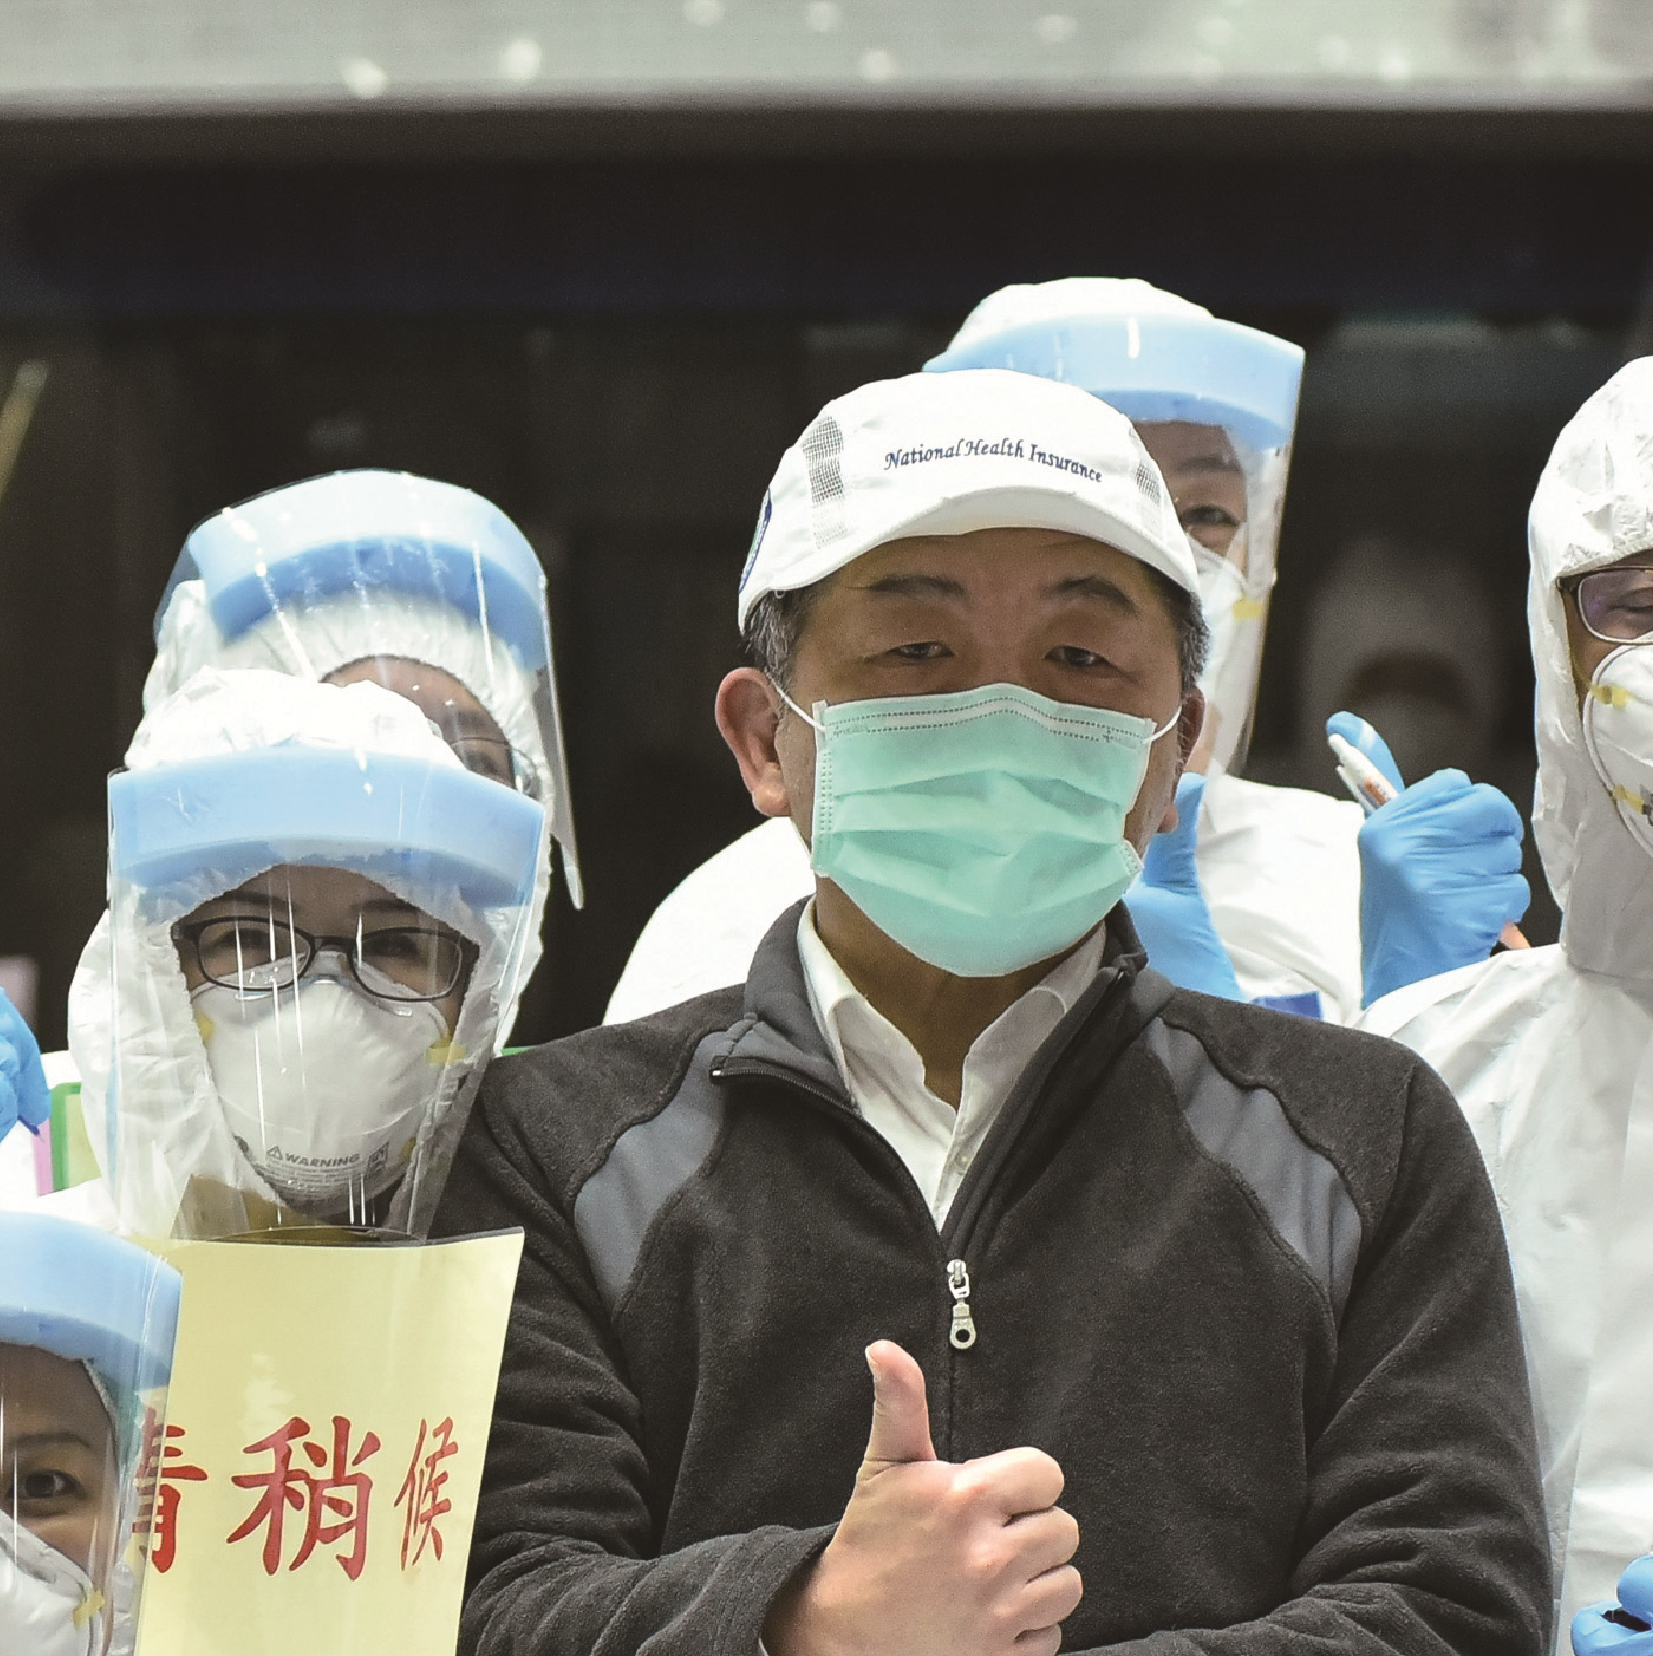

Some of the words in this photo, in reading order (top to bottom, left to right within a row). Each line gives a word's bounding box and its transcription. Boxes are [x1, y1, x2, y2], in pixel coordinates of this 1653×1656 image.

[883, 437, 966, 471] National
[964, 437, 1025, 460] Health
[1027, 443, 1103, 483] Insurance
[284, 1152, 361, 1168] WARNING
